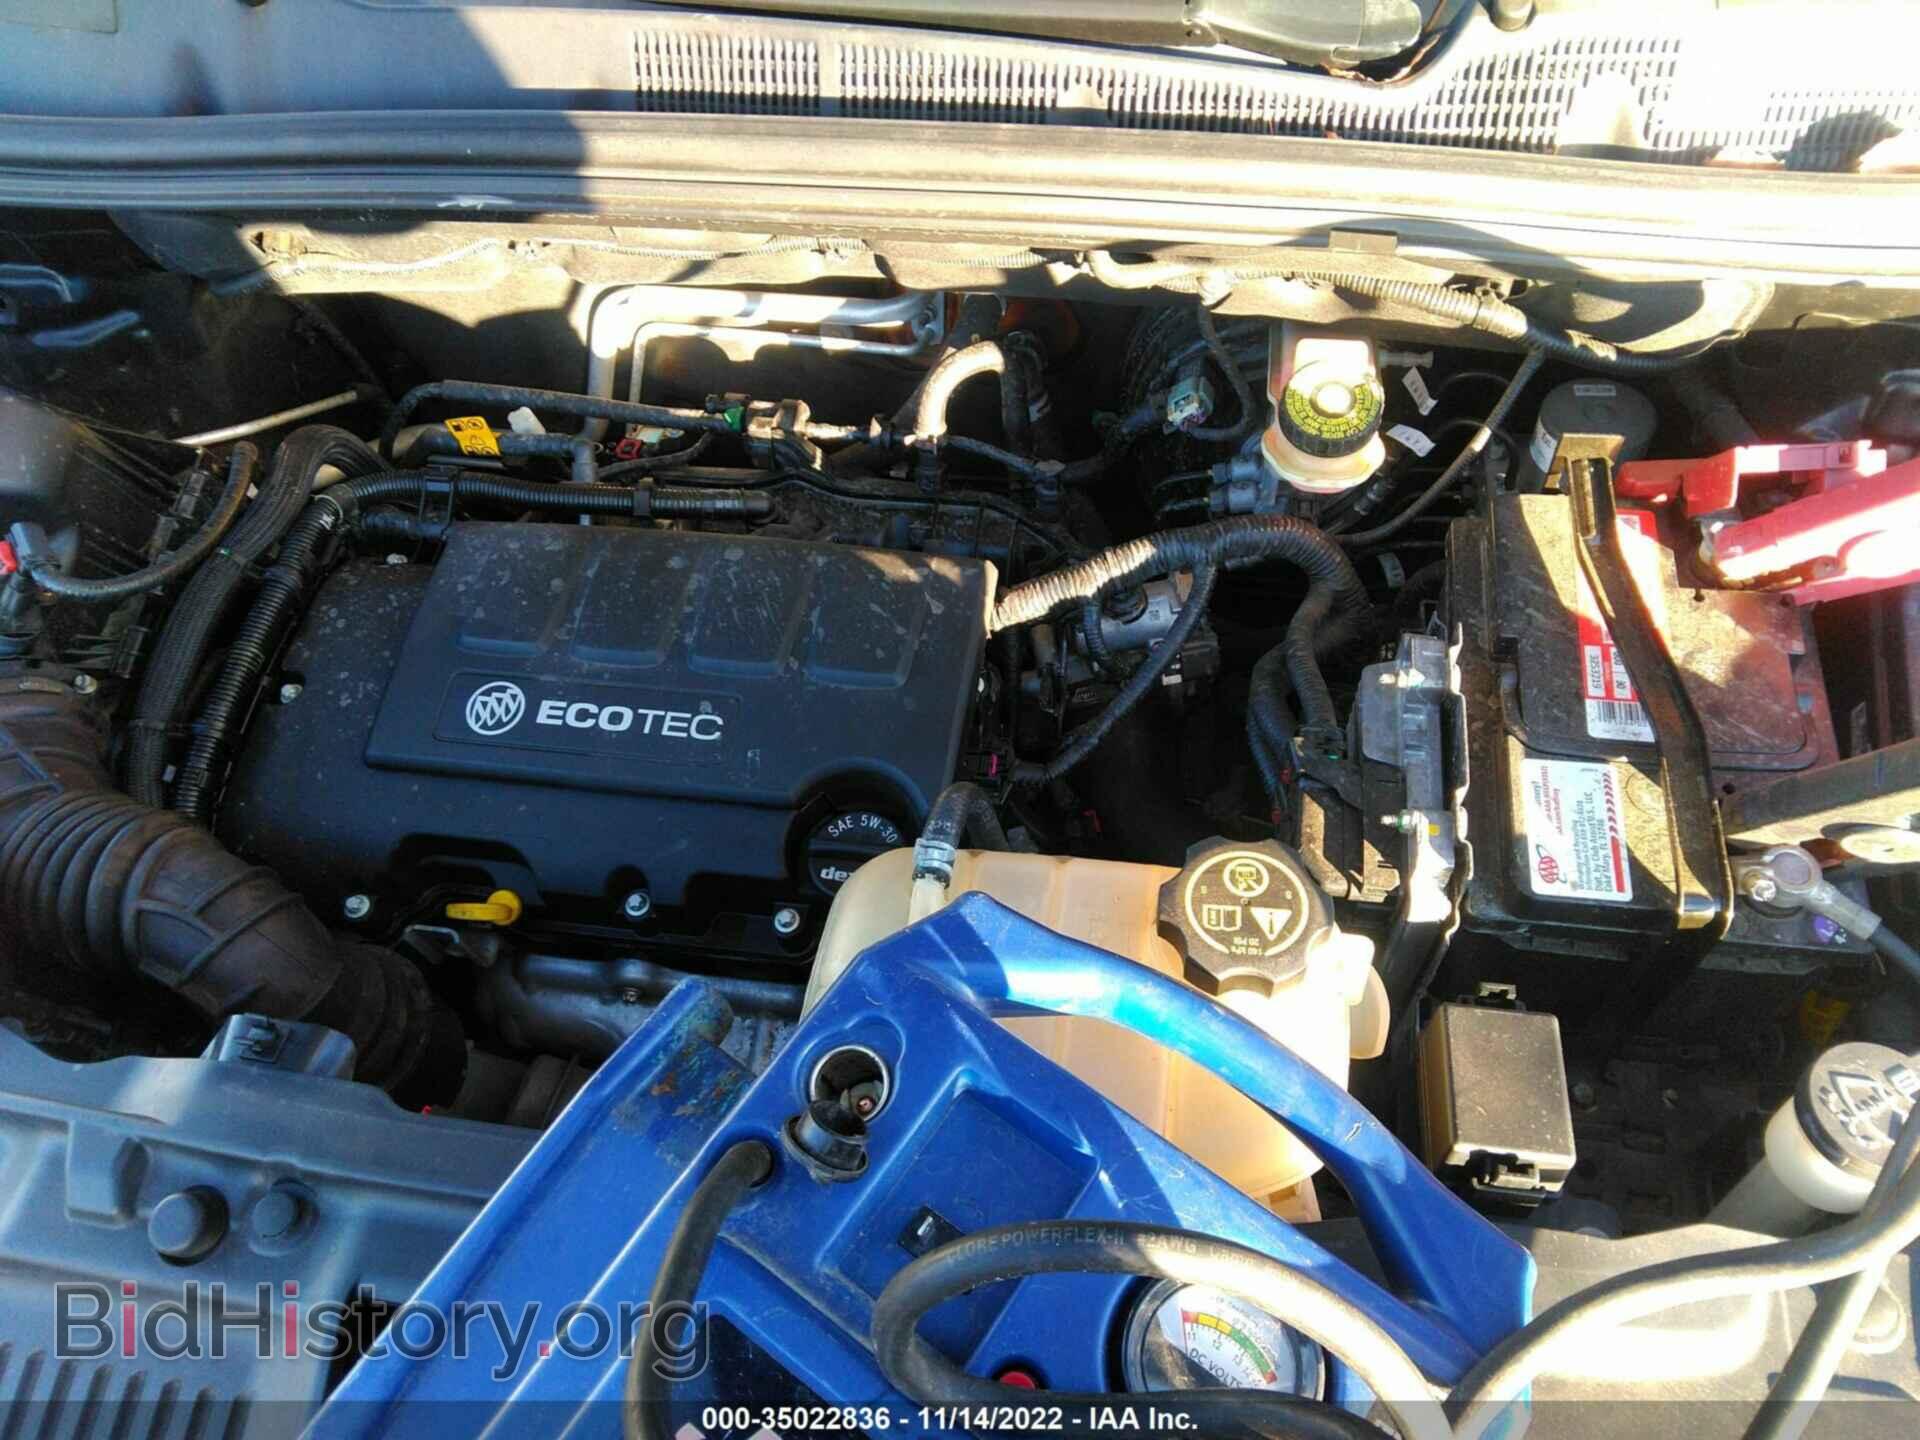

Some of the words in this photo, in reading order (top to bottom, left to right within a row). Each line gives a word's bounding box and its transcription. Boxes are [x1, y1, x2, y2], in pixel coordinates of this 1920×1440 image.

[536, 699, 724, 741] ECOTEC
[828, 815, 855, 837] SAE
[860, 814, 898, 843] 5W-30
[1537, 856, 1559, 883] AAA
[1190, 1347, 1208, 1365] DC
